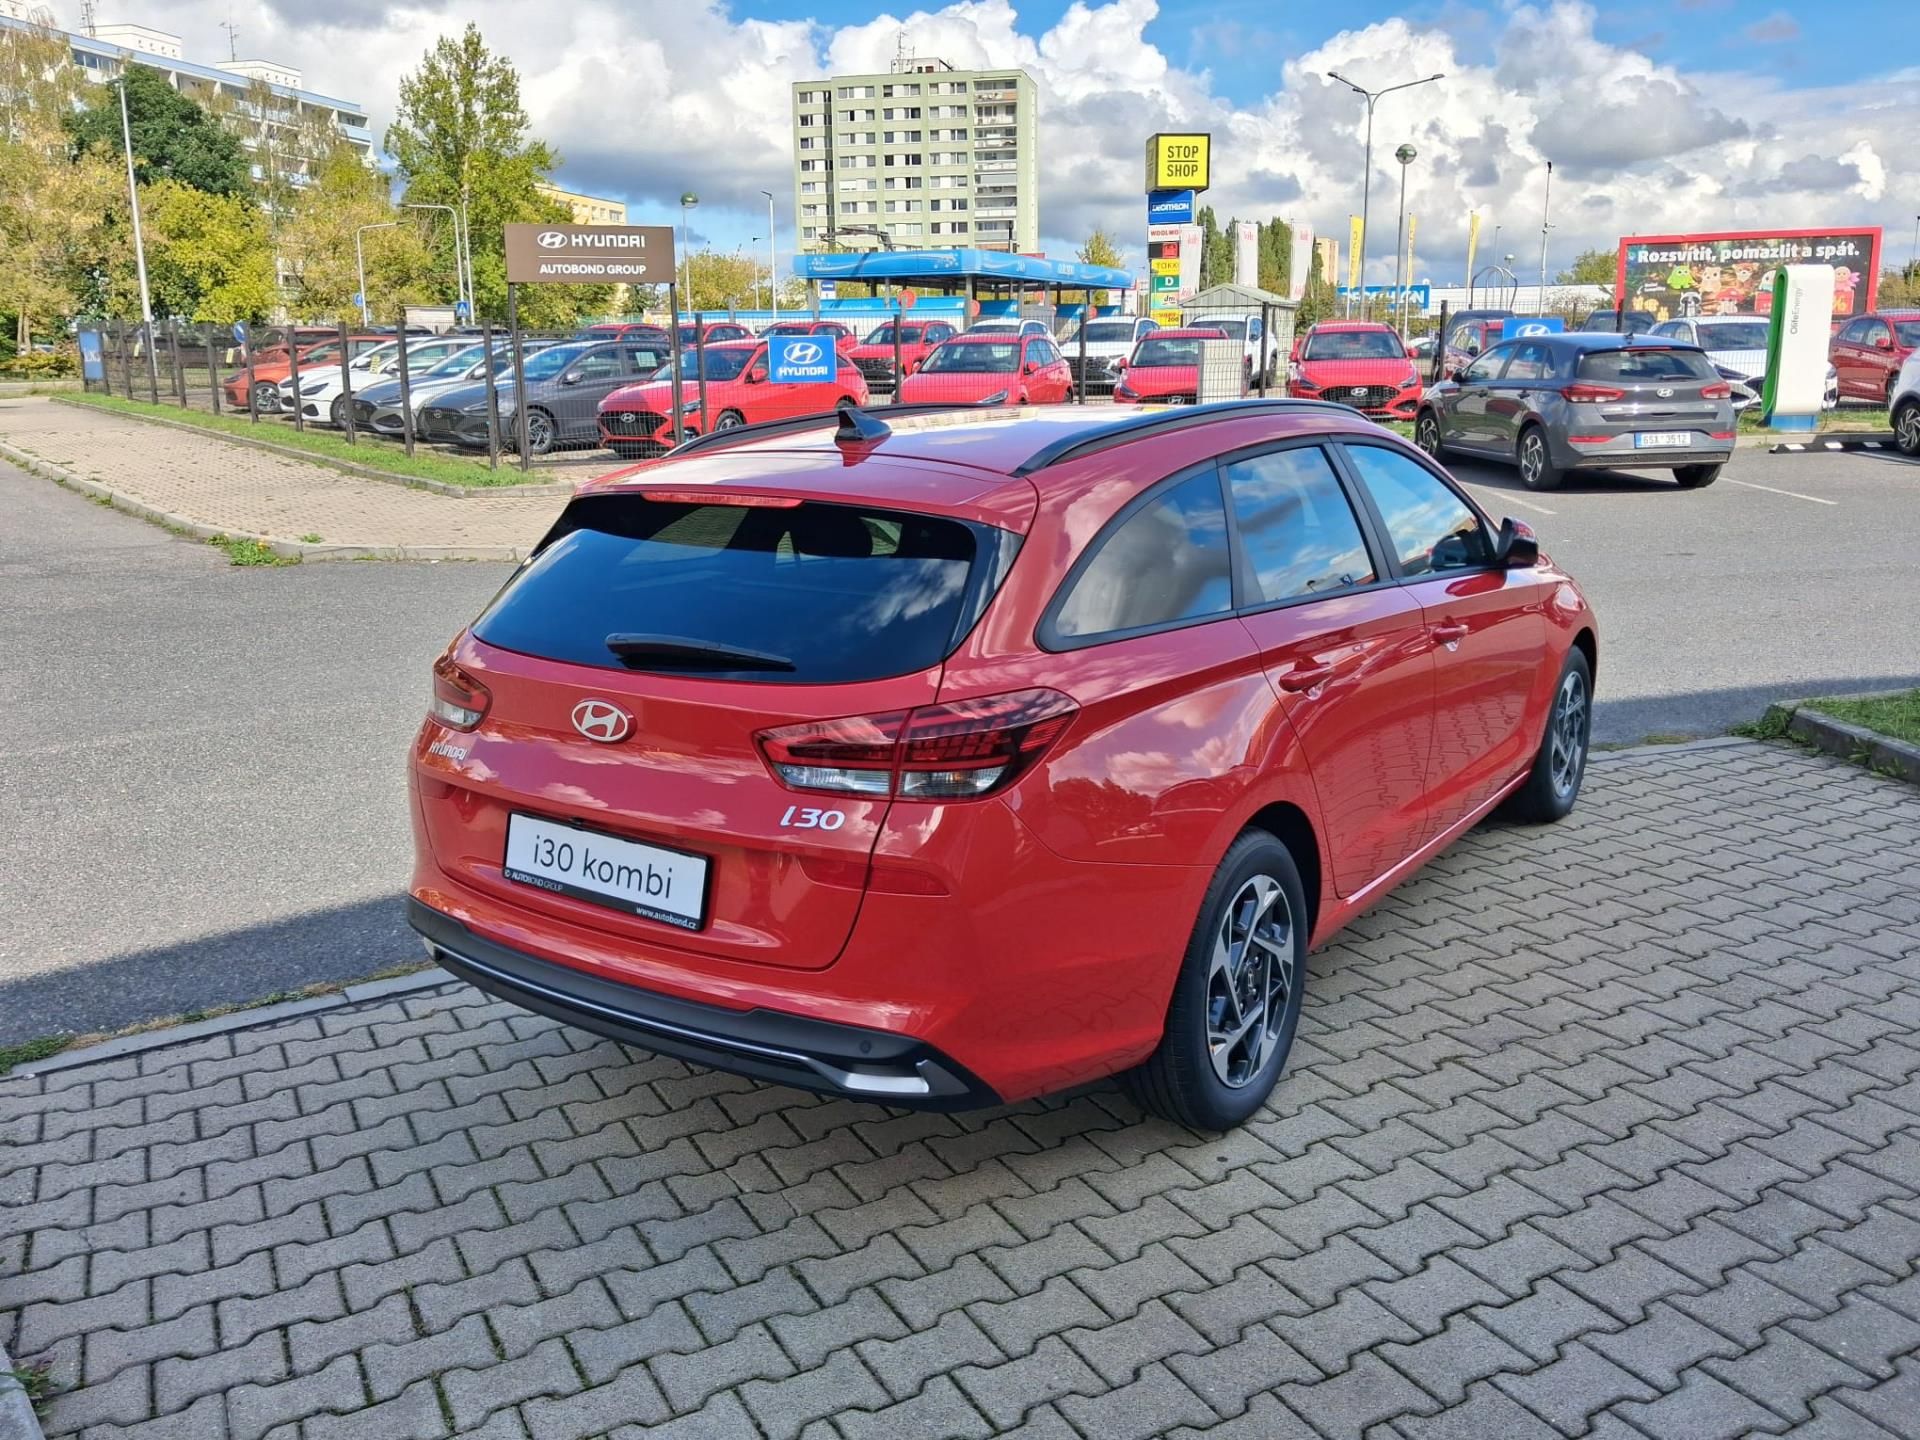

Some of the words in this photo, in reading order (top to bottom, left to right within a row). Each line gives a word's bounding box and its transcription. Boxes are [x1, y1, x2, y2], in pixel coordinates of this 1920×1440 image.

[1167, 145, 1199, 159] STOP
[1166, 163, 1199, 177] SHOP
[571, 234, 645, 248] HYUNDAI
[1637, 245, 1717, 263] Rozsvítit,
[1720, 243, 1799, 262] pomazlit
[1801, 248, 1813, 258] a
[1815, 240, 1860, 260] spát.
[539, 264, 605, 275] AUTOBOND
[606, 264, 646, 275] GROUP
[779, 366, 828, 376] HYUNDAI
[428, 741, 468, 760] HYUNDAI
[534, 835, 574, 872] i30
[583, 848, 673, 899] kombi
[511, 871, 544, 887] AUTOBOND
[543, 880, 563, 892] GROUP
[636, 905, 697, 930] www.autobond.cz
